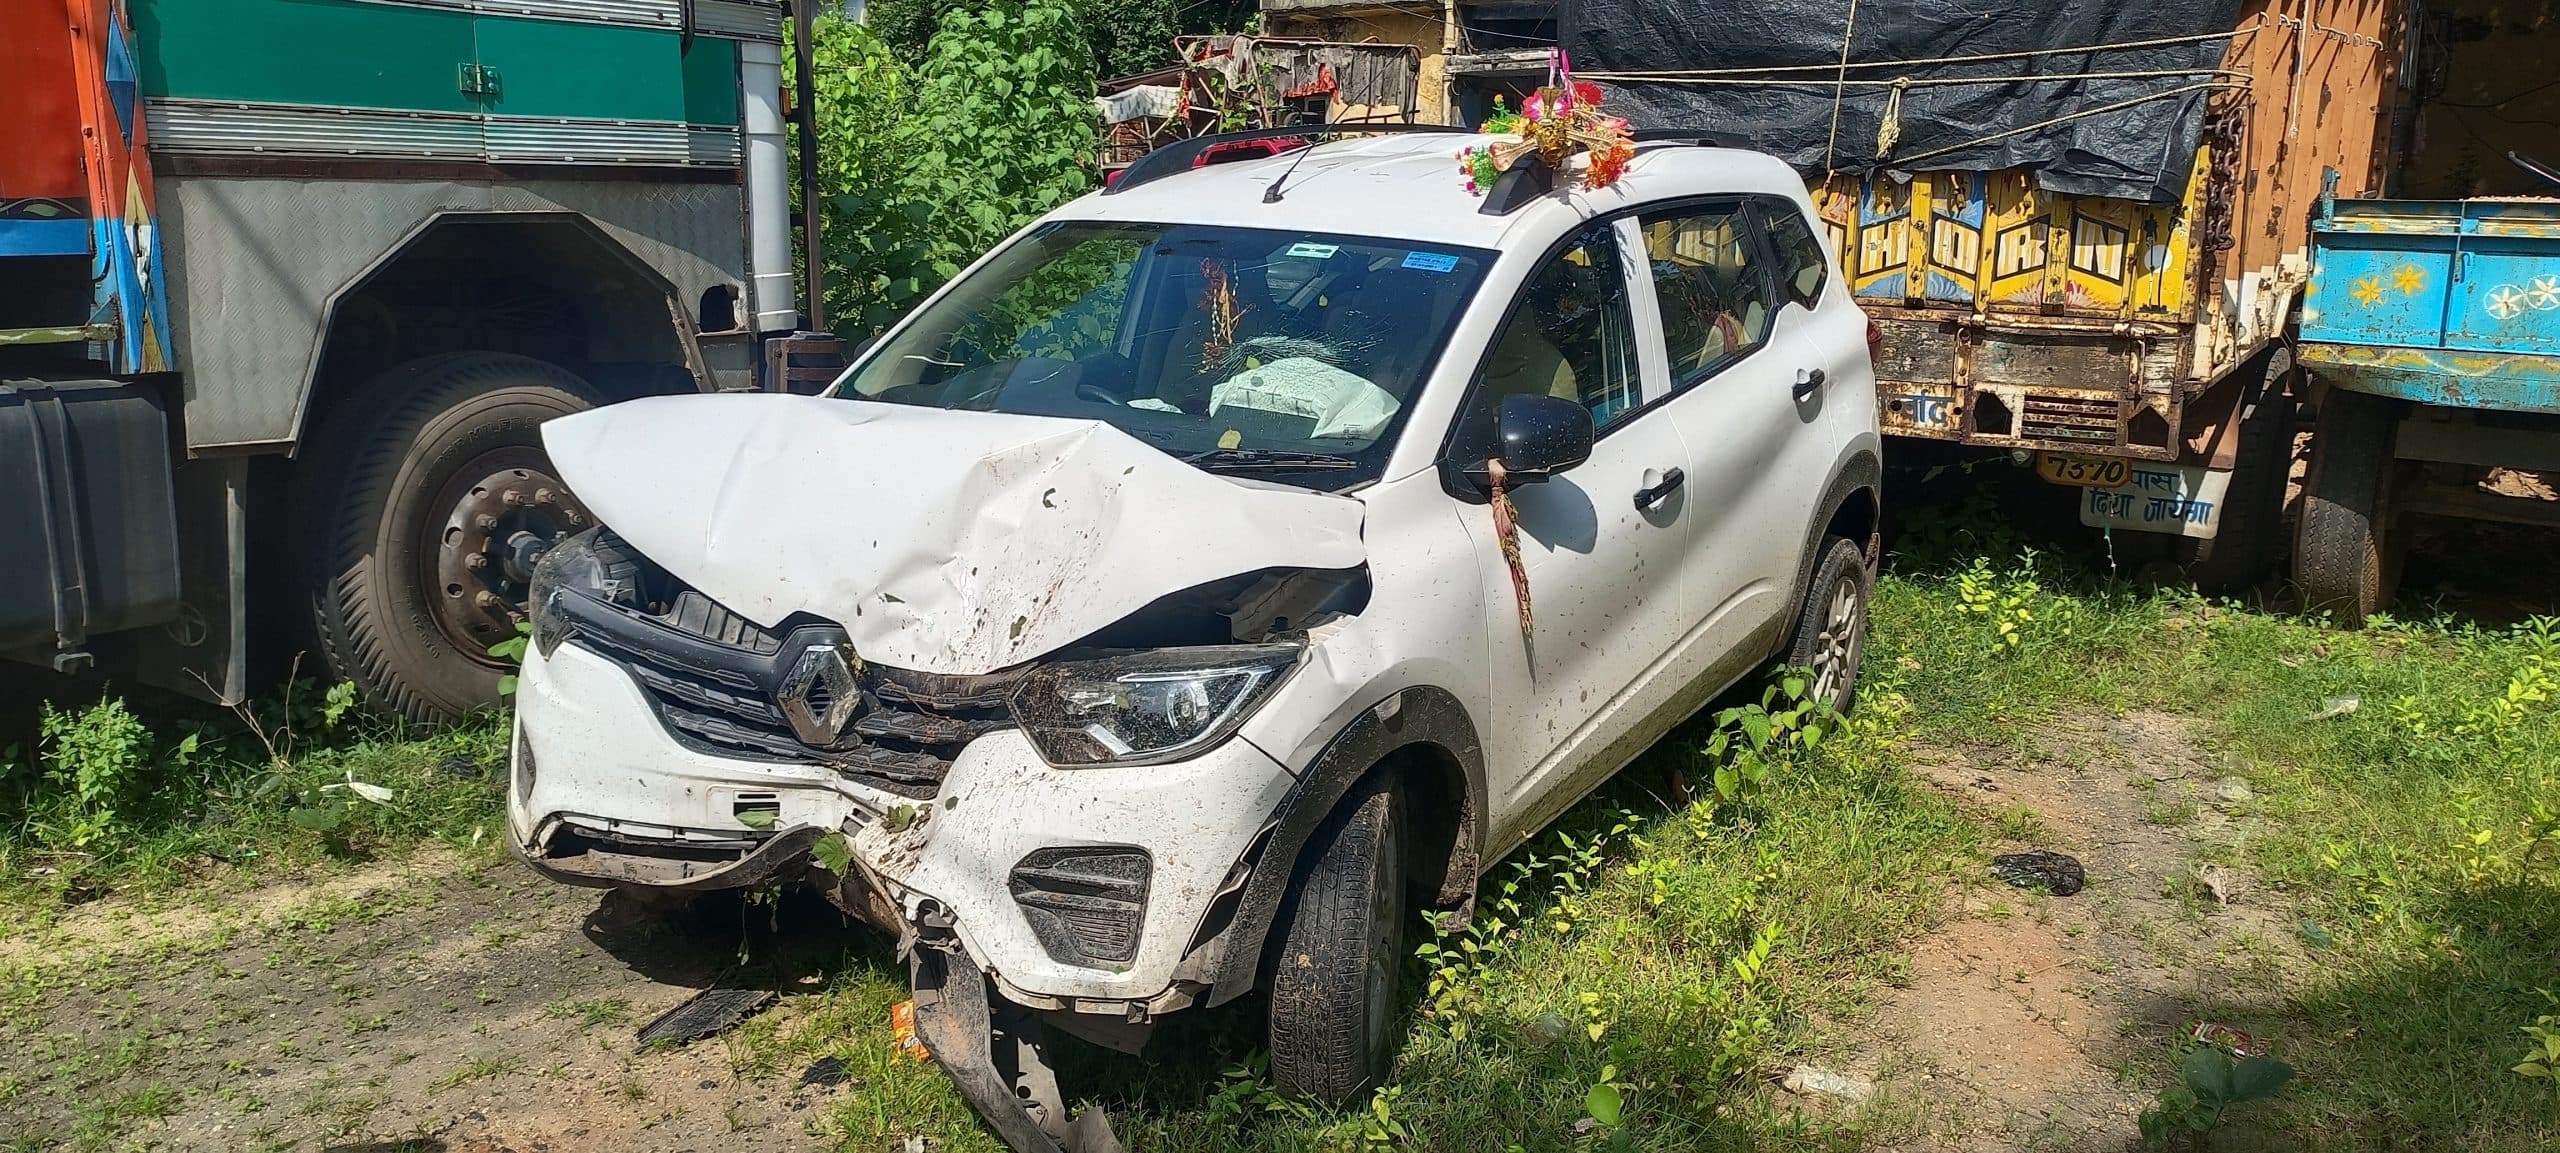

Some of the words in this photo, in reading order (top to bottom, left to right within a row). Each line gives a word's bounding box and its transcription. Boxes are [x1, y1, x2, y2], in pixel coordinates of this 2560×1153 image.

[1855, 210, 2128, 286] HORN
[2131, 470, 2179, 493] पास
[2089, 488, 2135, 519] दिया
